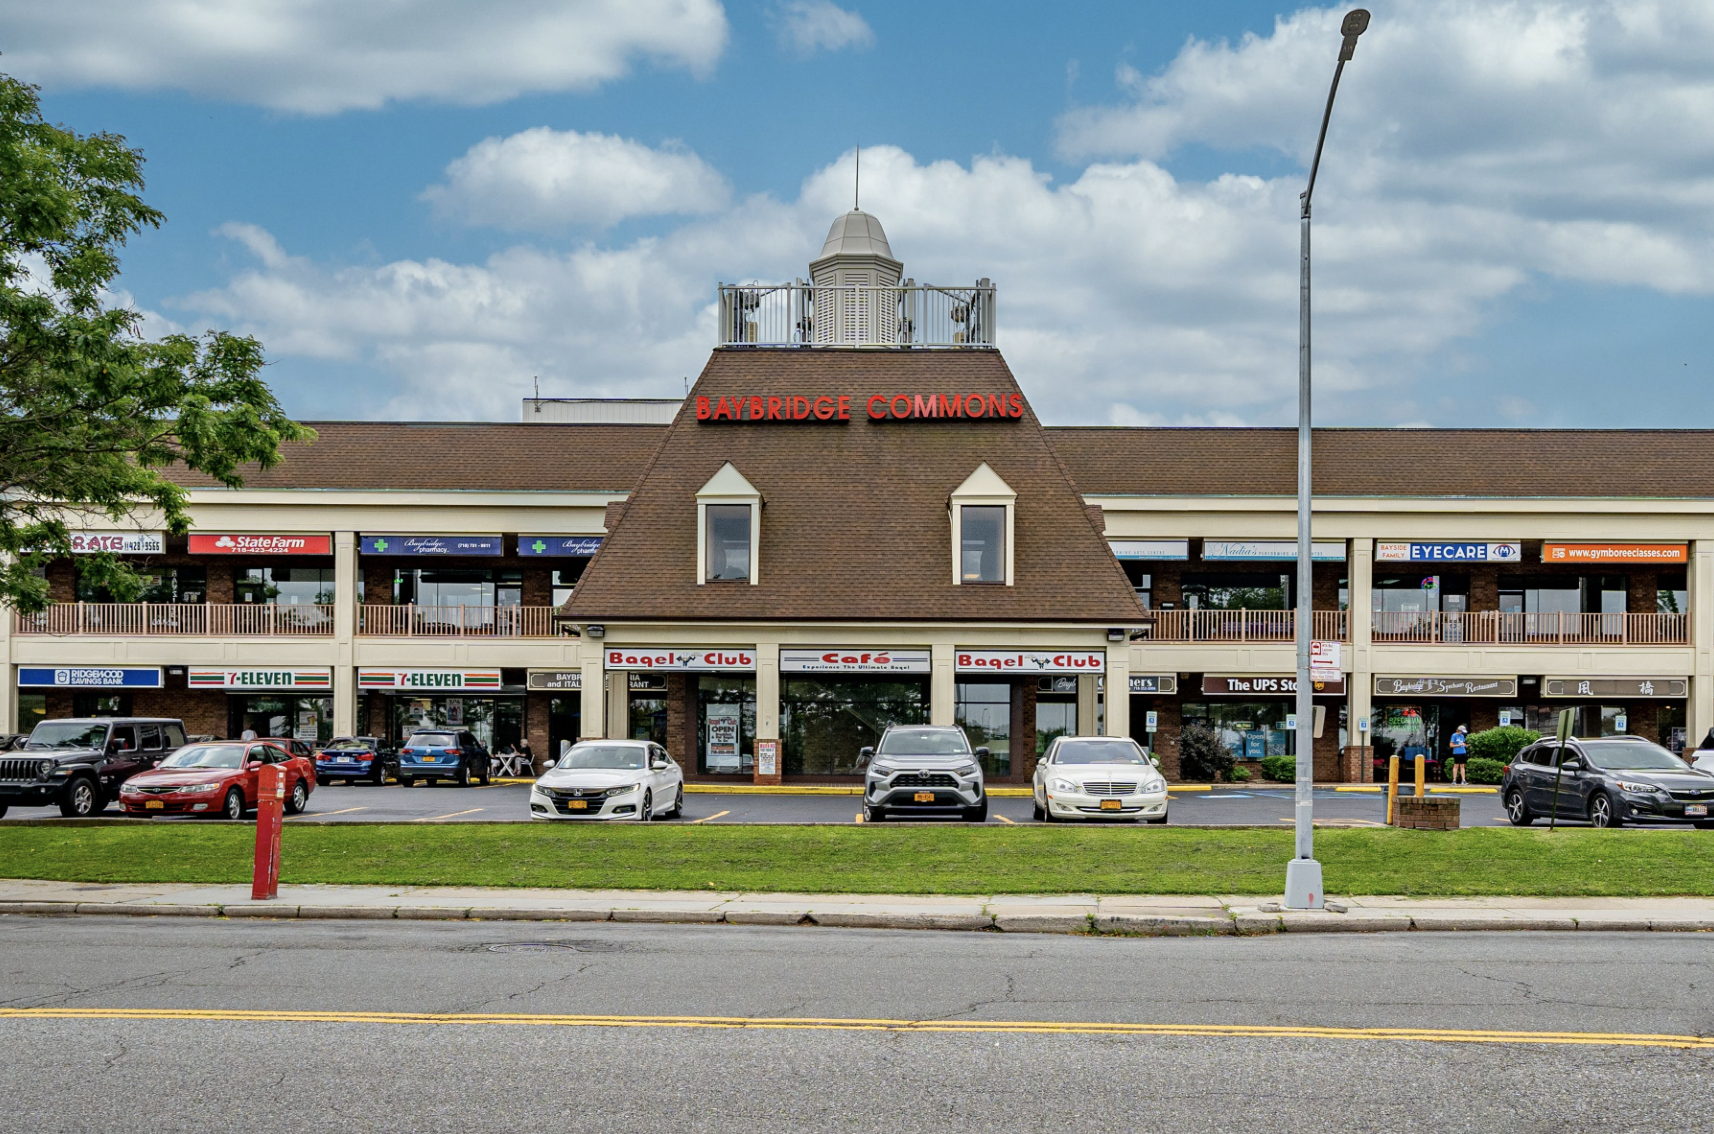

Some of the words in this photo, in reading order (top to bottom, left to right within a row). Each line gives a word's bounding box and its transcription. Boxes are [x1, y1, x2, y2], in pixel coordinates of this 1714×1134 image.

[696, 395, 850, 420] BAYBRIDGE
[866, 393, 1023, 419] COMMONS
[71, 535, 123, 551] RATE
[1213, 541, 1257, 558] Nadia's
[1411, 545, 1486, 559] EYECARE
[1568, 547, 1680, 559] www.gymboreeclasses.com
[609, 652, 674, 669] Bagel
[704, 652, 752, 666] Club
[822, 652, 890, 664] Café
[958, 654, 1023, 670] Bagel
[1053, 654, 1101, 668] Club
[71, 669, 124, 678] RIDGEWOOD
[71, 677, 102, 685] SAVINGS
[103, 677, 123, 685] BANK
[227, 671, 292, 686] 7-ELEVEN
[397, 672, 462, 687] 7-ELEVEN
[1227, 678, 1250, 691] The
[1252, 678, 1278, 691] UPS
[1280, 678, 1298, 691] Sto
[1464, 681, 1498, 693] Restaurant
[1578, 681, 1593, 696] 風
[1638, 681, 1655, 696] 橋
